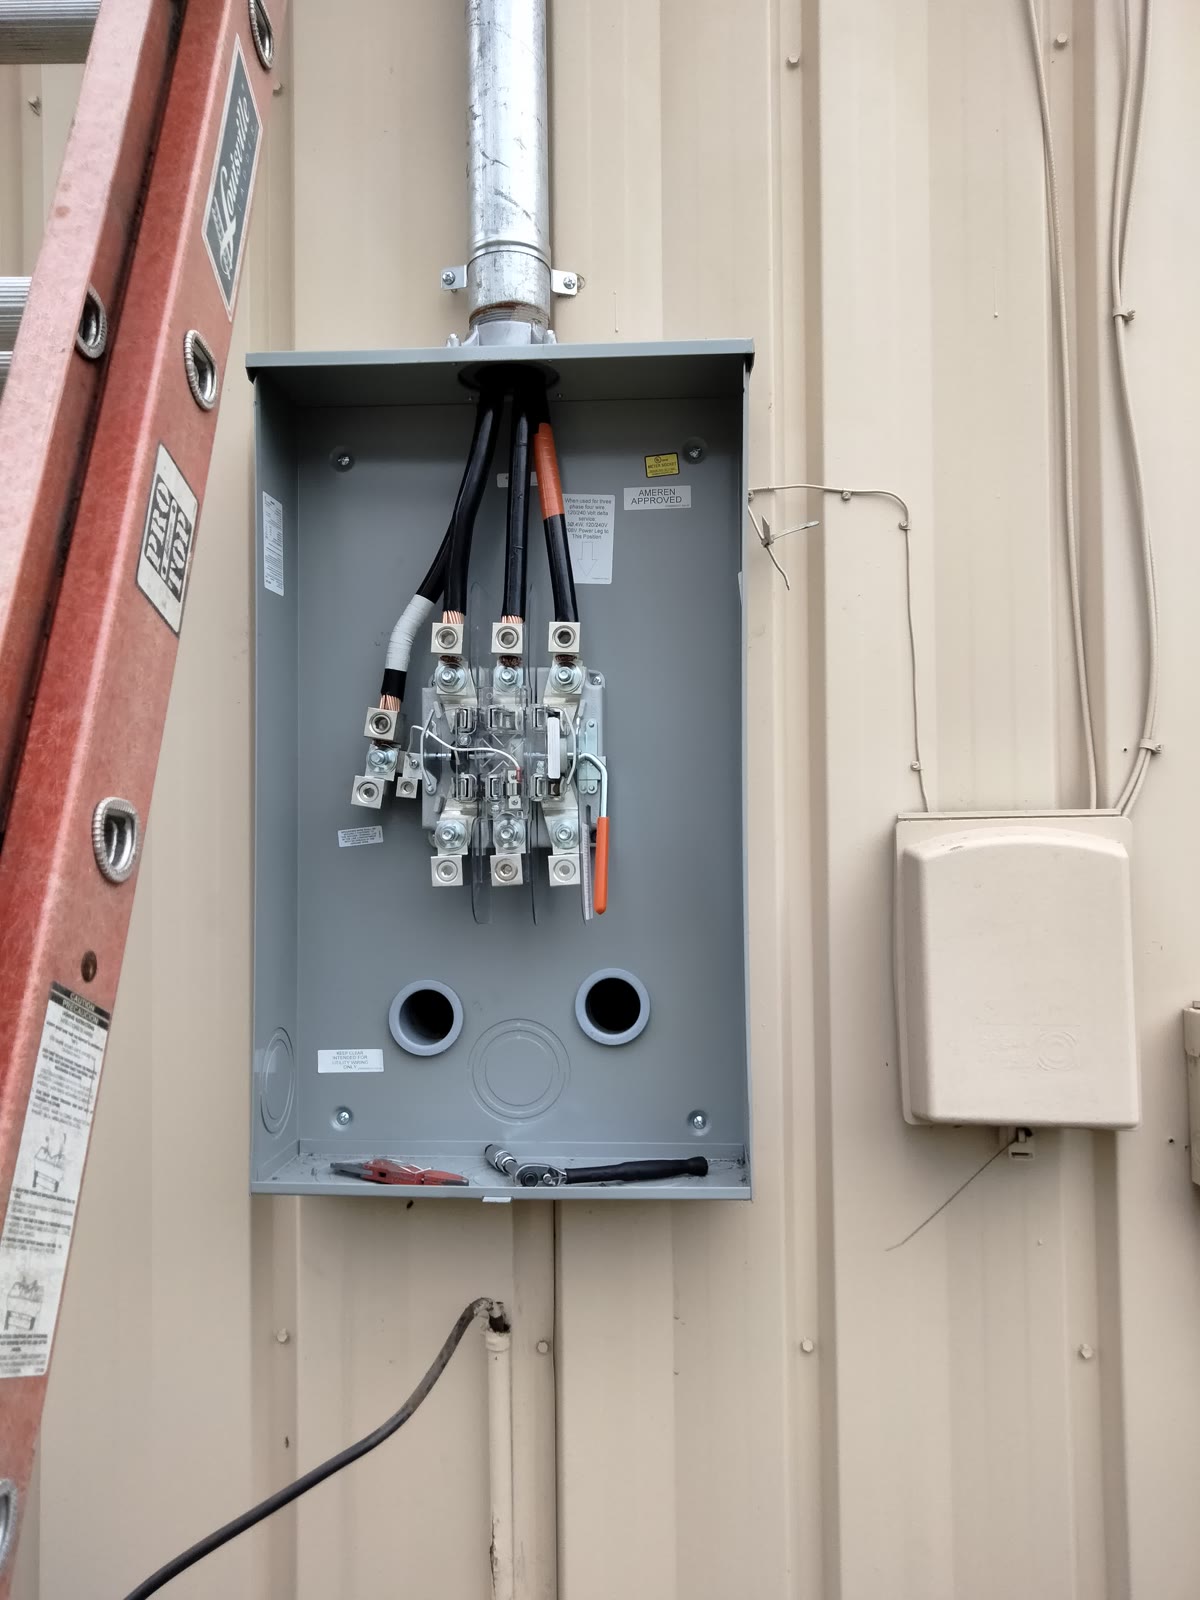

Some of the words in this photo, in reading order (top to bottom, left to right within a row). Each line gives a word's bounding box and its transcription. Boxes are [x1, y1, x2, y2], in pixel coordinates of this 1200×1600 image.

[217, 97, 250, 248] Louisville
[630, 495, 682, 505] APPROVED
[638, 488, 676, 497] AMEREN
[145, 481, 170, 573] PRO
[168, 511, 190, 595] TOP
[70, 992, 95, 1012] CAUTION
